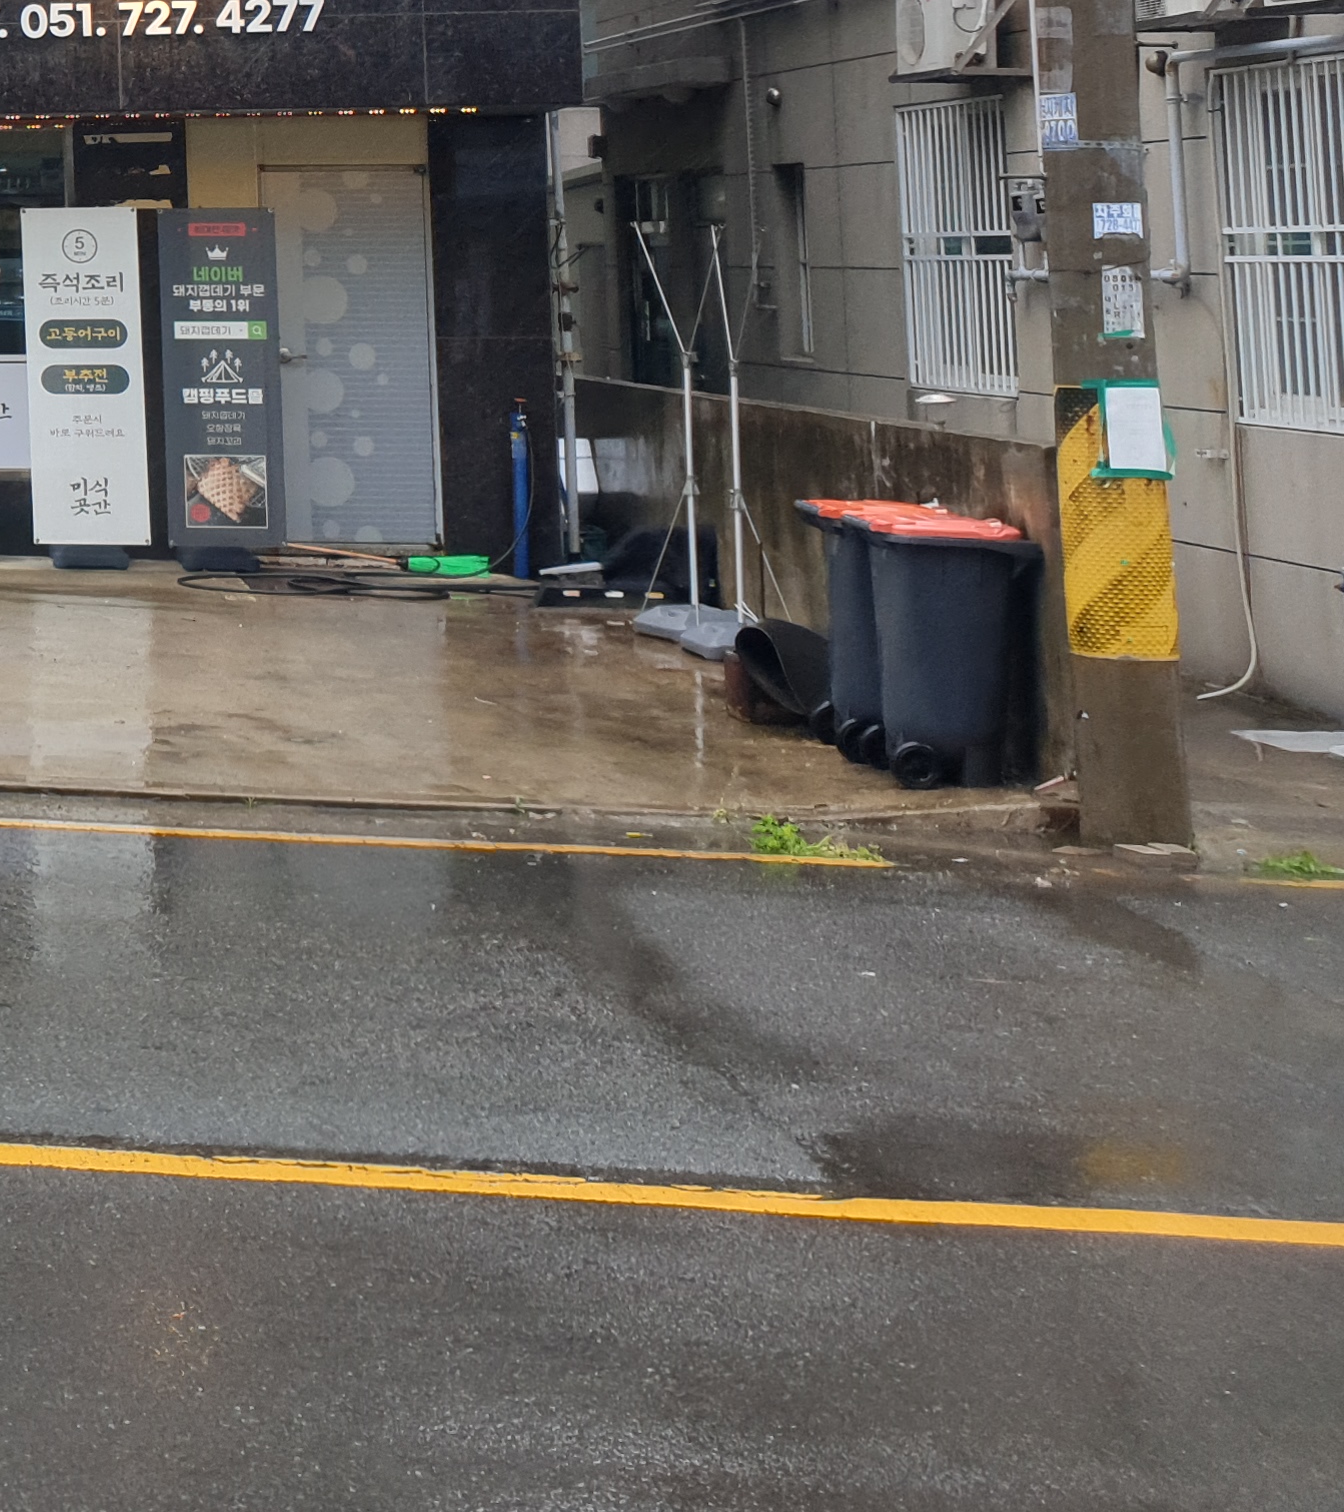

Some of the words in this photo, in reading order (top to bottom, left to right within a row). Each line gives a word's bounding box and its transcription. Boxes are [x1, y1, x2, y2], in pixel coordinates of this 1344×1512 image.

[20, 3, 107, 39] 051.
[118, 0, 205, 37] 727.
[74, 236, 85, 250] 5
[193, 266, 243, 282] 네이버
[38, 272, 125, 294] 즉석조리
[172, 284, 235, 297] 돼지껍데기
[239, 284, 266, 297] 부문
[50, 295, 92, 307] (조리시간
[94, 295, 115, 307] 5분)
[189, 299, 227, 313] 부동의
[230, 299, 250, 313] 1위
[46, 326, 122, 342] 고등어구이
[179, 325, 231, 336] 돼지껍데기
[63, 368, 109, 383] 부추전
[72, 414, 102, 425] 주문시
[50, 428, 71, 438] 바로
[70, 476, 109, 498] 미식
[71, 497, 111, 517] 곳간
